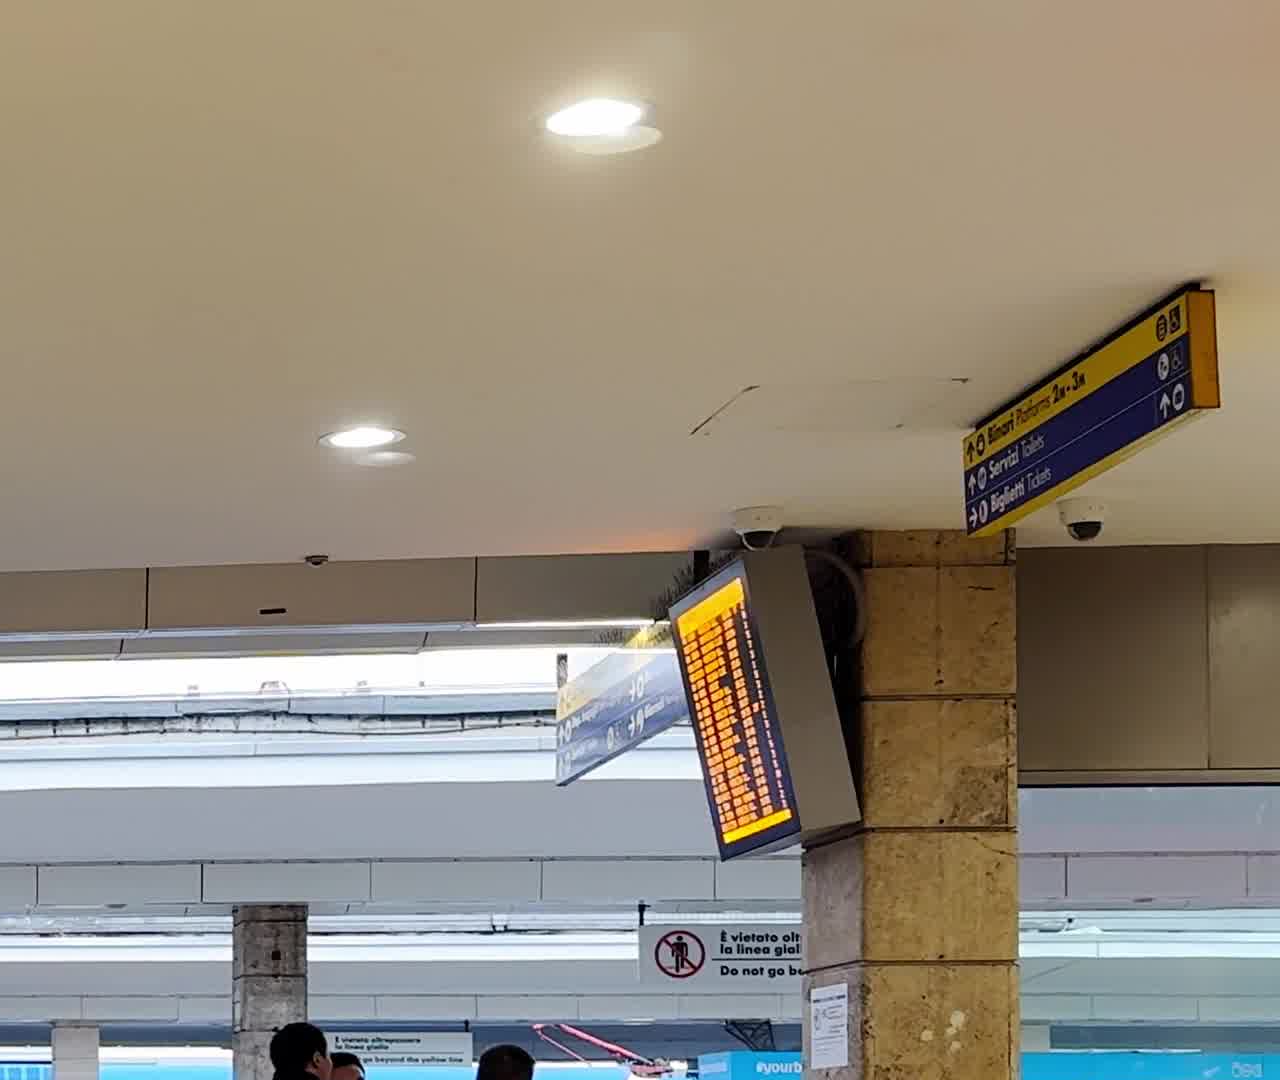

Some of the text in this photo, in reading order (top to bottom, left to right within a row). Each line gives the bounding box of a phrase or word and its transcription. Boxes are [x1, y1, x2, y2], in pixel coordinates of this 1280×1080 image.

[989, 436, 1045, 478] Servizi Toilets
[1026, 467, 1052, 491] Tickets
[731, 931, 778, 942] vietato
[720, 944, 733, 955] la
[736, 944, 771, 955] linea
[720, 966, 739, 976] Do
[742, 966, 765, 976] not
[768, 968, 785, 978] go
